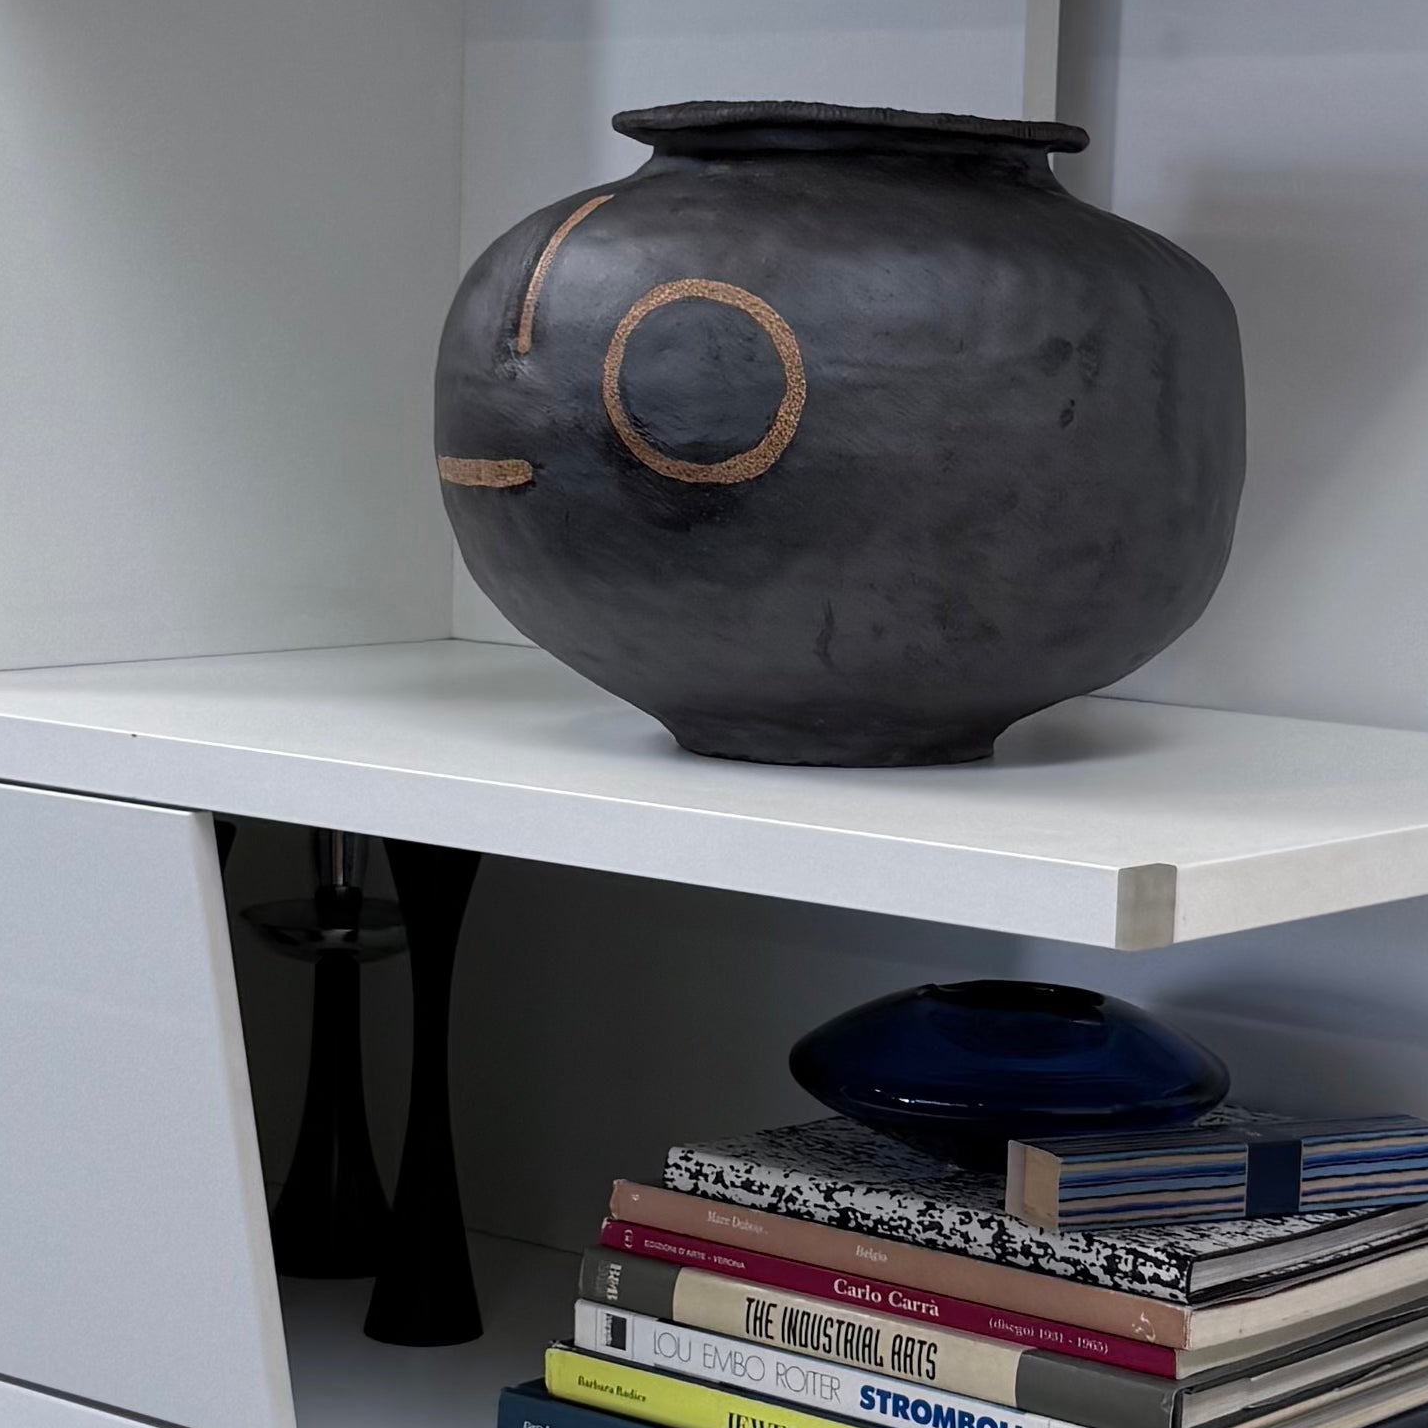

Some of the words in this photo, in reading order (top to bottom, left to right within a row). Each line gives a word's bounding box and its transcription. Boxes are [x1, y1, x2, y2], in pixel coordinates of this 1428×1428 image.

[713, 1255, 746, 1269] VERONA
[832, 1278, 883, 1304] Carlo
[887, 1291, 941, 1318] Carrà
[653, 1327, 693, 1363] LOU
[702, 1342, 766, 1382] EMBO
[775, 1360, 842, 1404] ROITER
[745, 1296, 778, 1341] THE
[780, 1304, 884, 1368] INDUSTRIAL
[890, 1333, 939, 1381] ARTS
